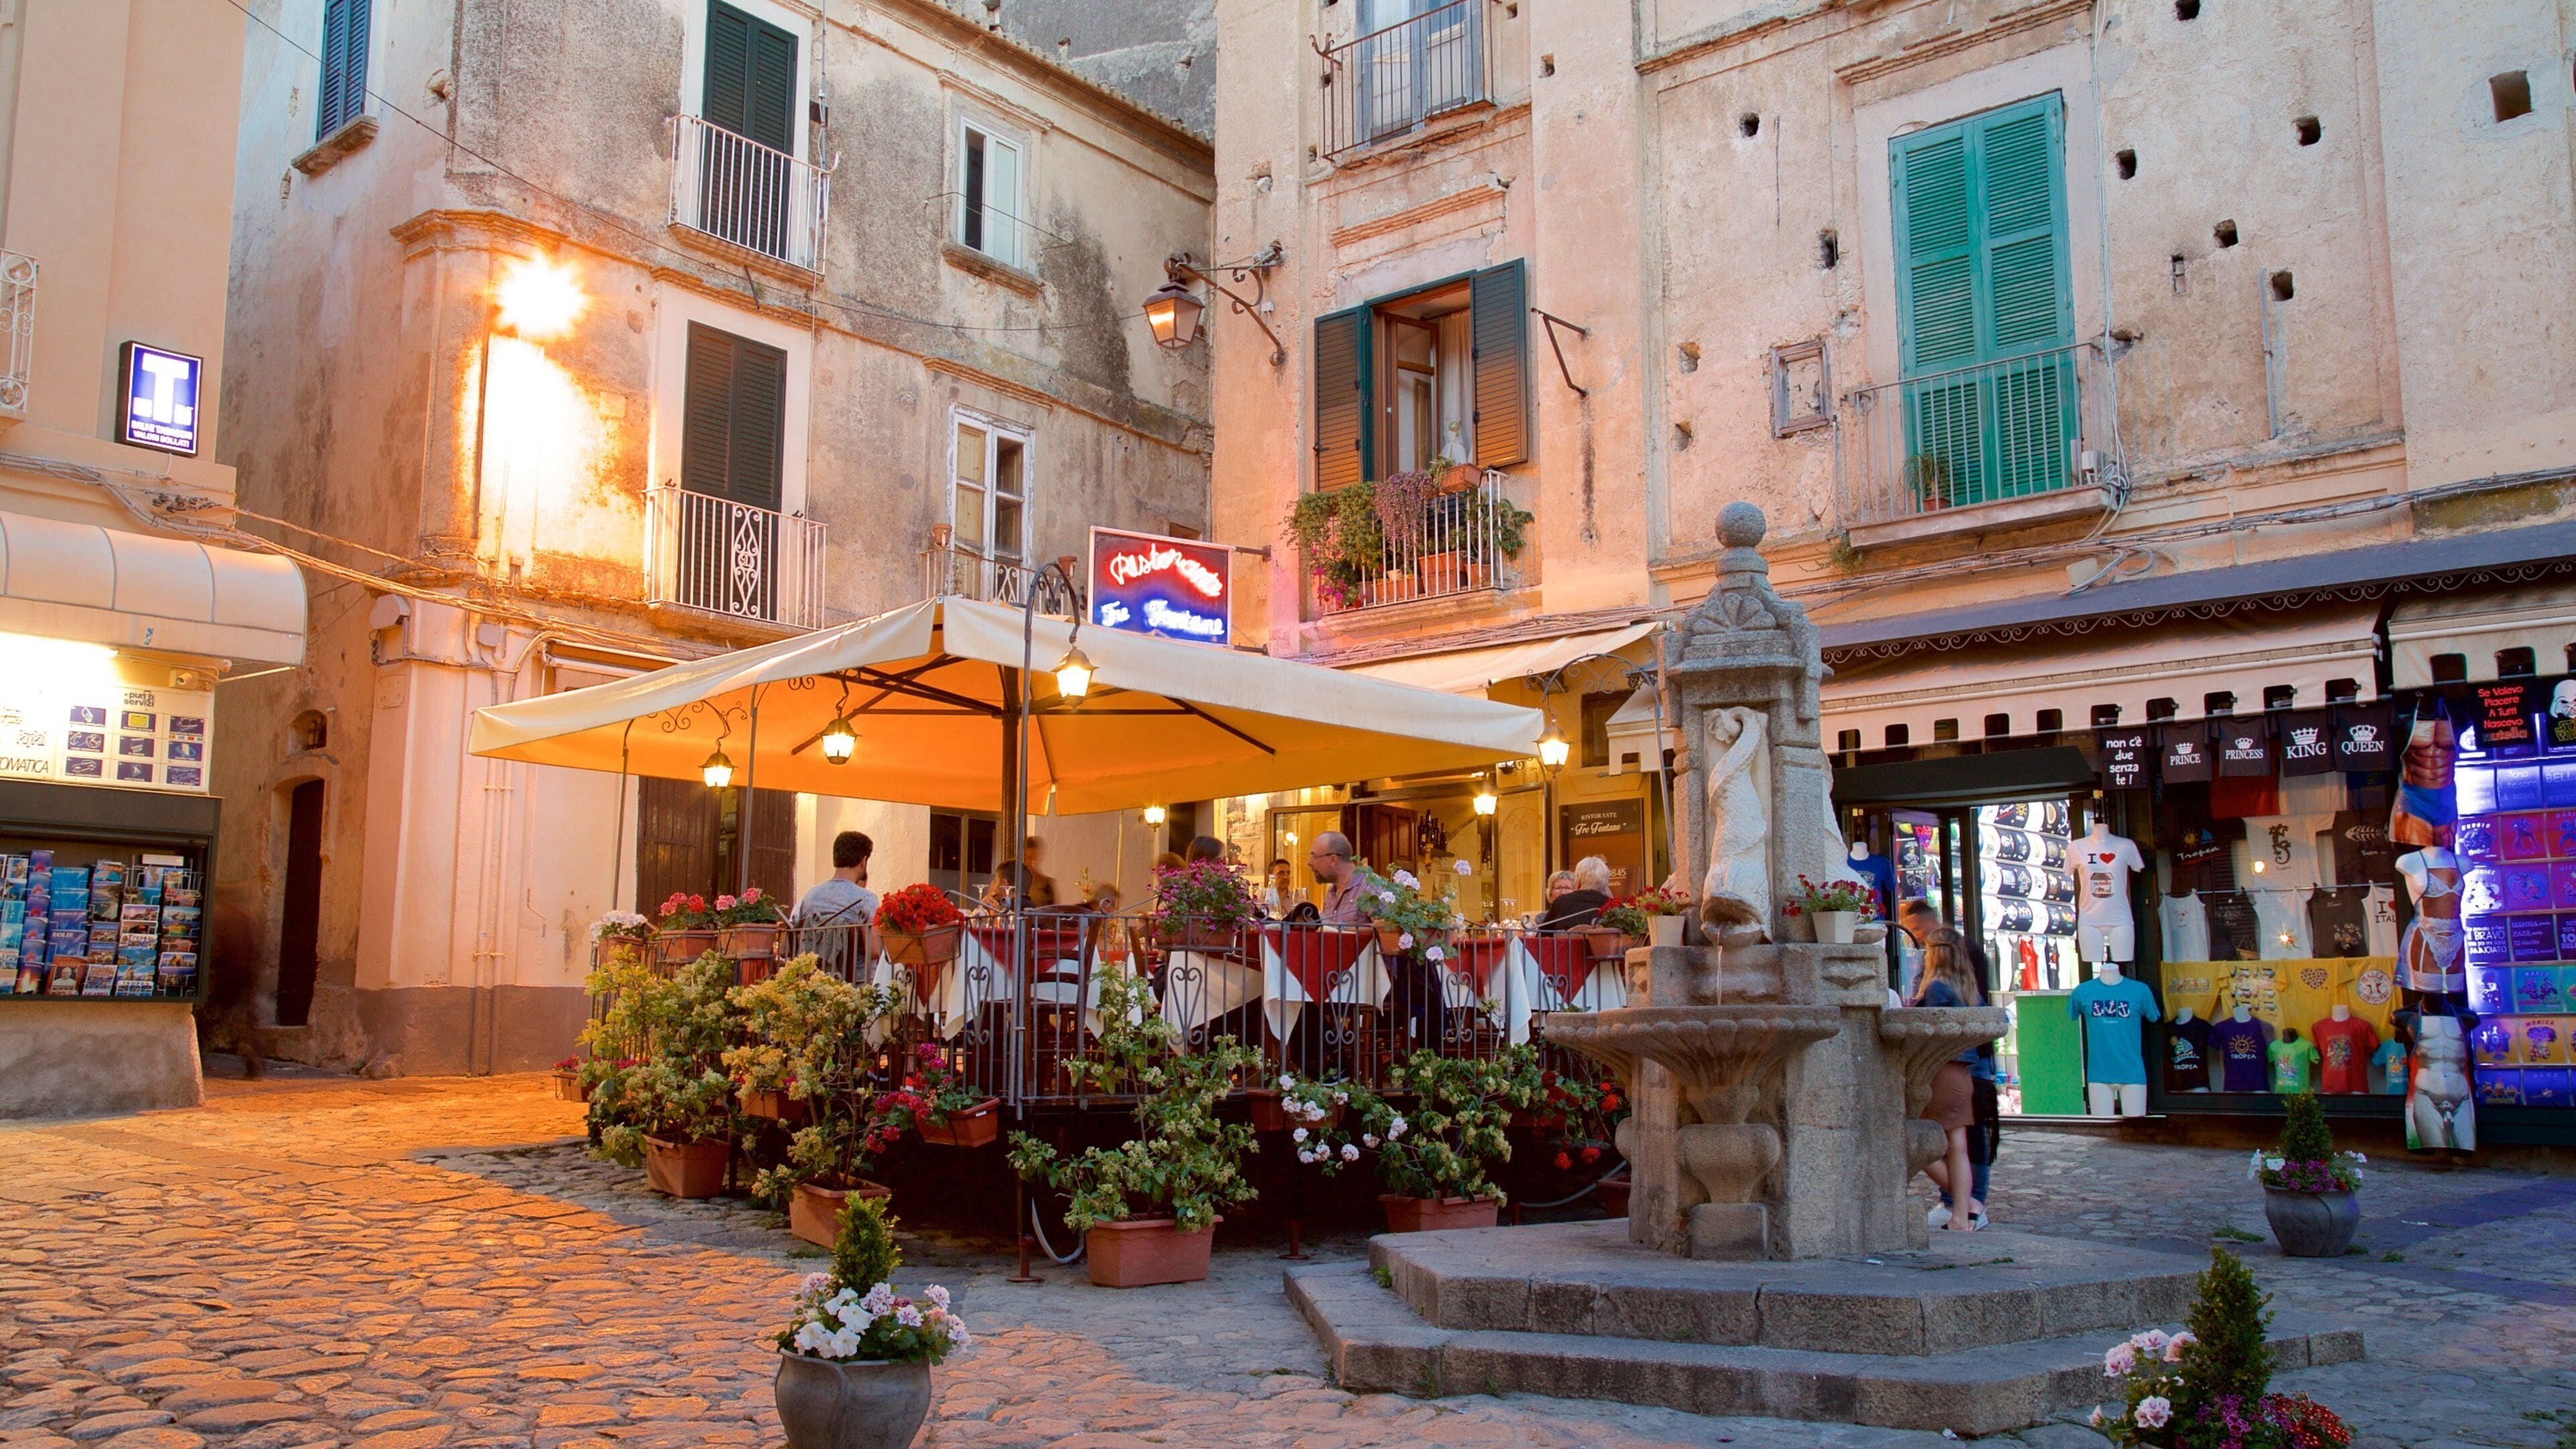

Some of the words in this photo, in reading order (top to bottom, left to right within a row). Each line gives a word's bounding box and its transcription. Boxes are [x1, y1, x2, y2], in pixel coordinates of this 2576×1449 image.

[142, 352, 189, 424] T
[2477, 688, 2491, 697] Se
[2492, 686, 2524, 696] Volevo
[123, 698, 154, 708] servizi
[2484, 696, 2520, 706] Piacere
[2489, 709, 2496, 717] A
[2497, 707, 2517, 716] Tutti
[2484, 718, 2524, 729] Nascevo
[2482, 727, 2528, 742] nutella
[2106, 739, 2126, 748] non
[2129, 736, 2143, 747] c'è
[2286, 742, 2328, 759] KING
[2341, 741, 2384, 755] QUEEN
[2114, 749, 2134, 761] due
[2169, 753, 2201, 765] PRINCE
[2224, 749, 2263, 759] PRINCESS
[0, 756, 49, 773] OMATICA
[2109, 763, 2139, 773] senza
[2115, 774, 2126, 786] te
[1580, 812, 1617, 820] RISTORANTE
[2088, 853, 2097, 864] I
[2177, 846, 2220, 861] Tropea
[2377, 901, 2387, 914] I
[2473, 930, 2506, 941] BRAVO
[2526, 1019, 2555, 1027] MONICA
